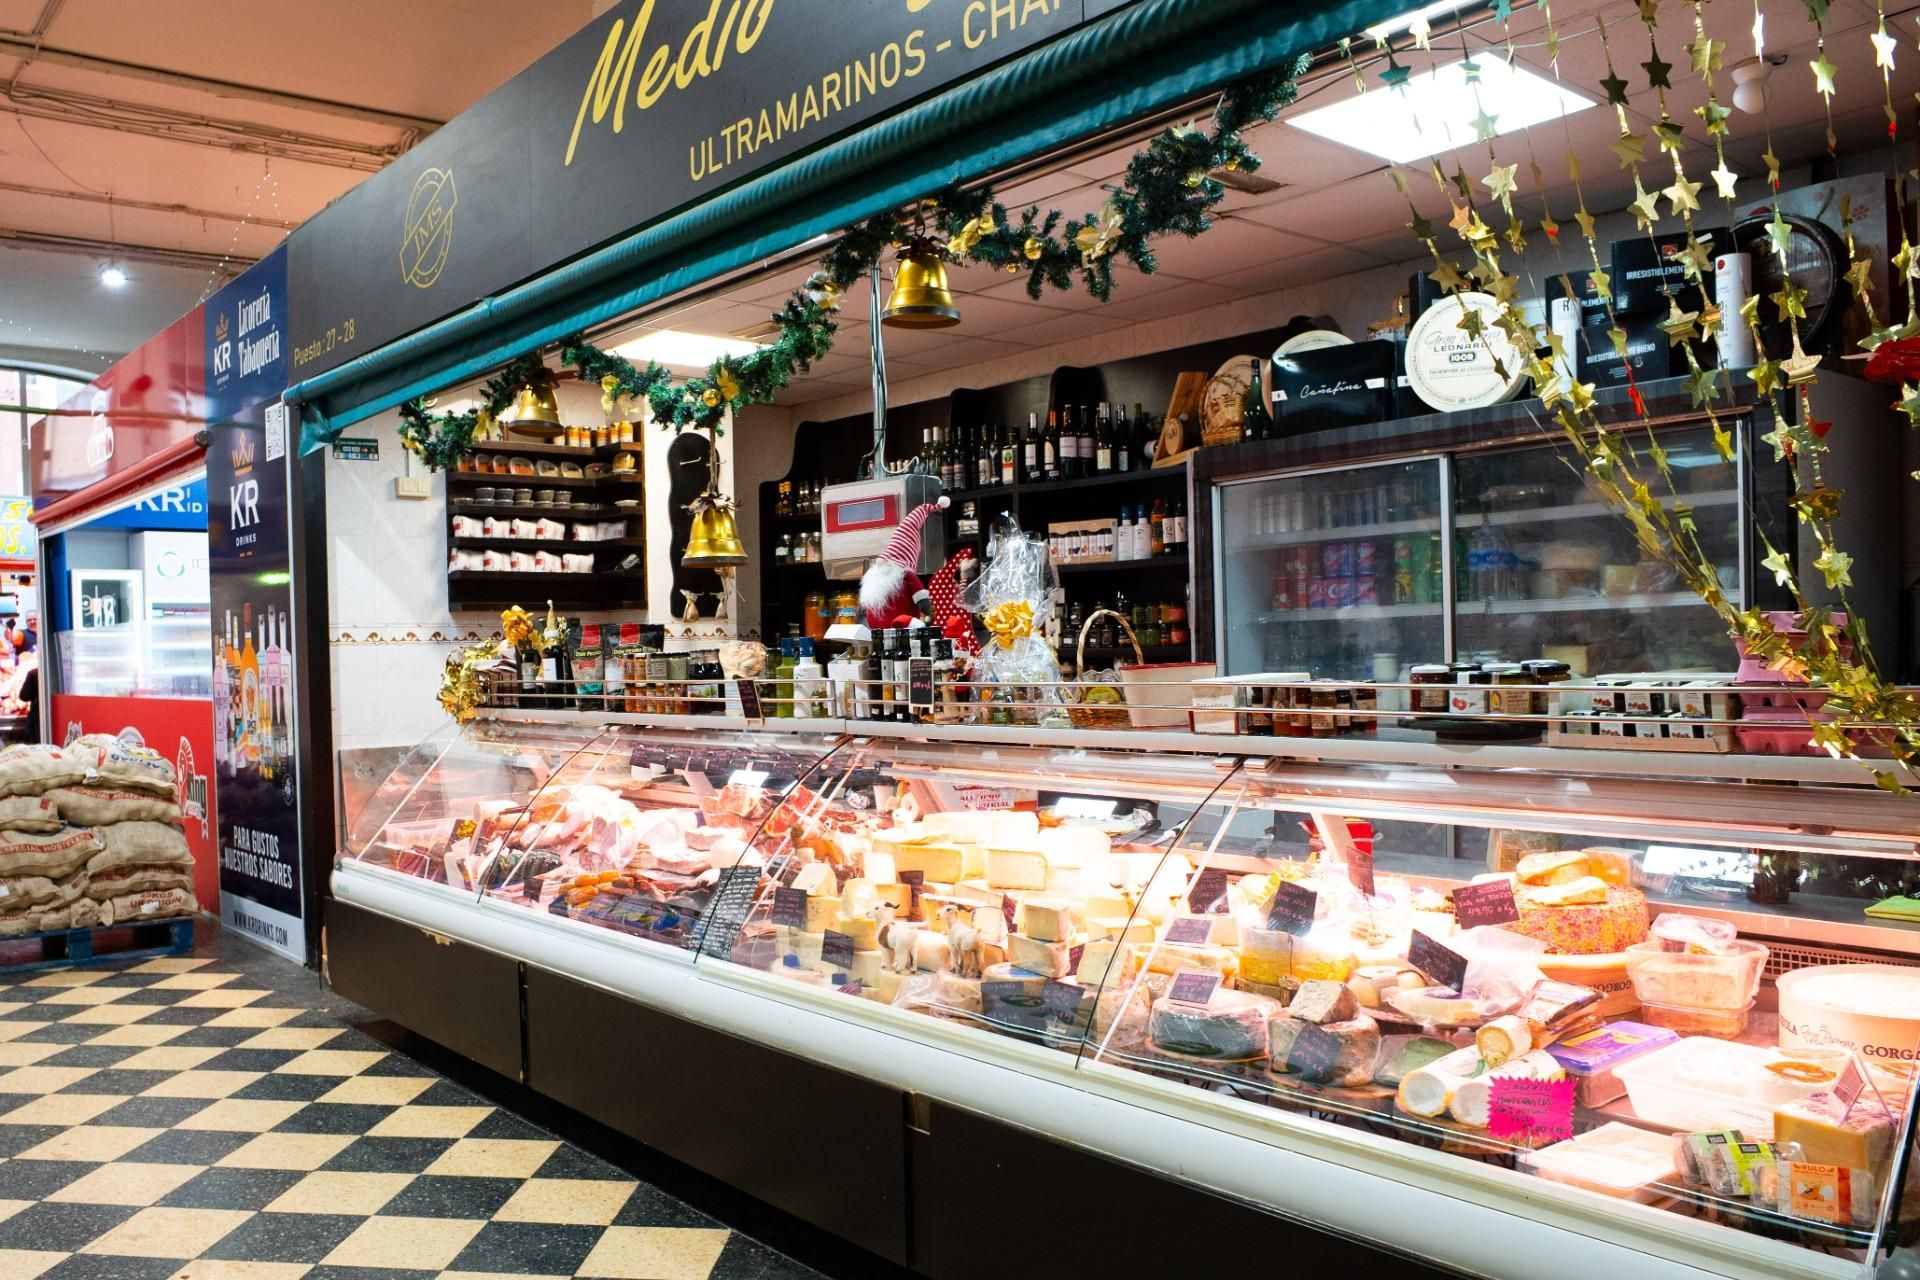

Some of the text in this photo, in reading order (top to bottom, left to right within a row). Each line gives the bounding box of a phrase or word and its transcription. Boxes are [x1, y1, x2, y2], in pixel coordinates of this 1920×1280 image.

[690, 29, 926, 181] ULTRAMARINOS
[326, 327, 337, 352] 27
[343, 318, 356, 344] 28
[214, 341, 232, 376] KR
[230, 479, 262, 531] KR
[236, 535, 258, 548] DRINKS
[234, 825, 279, 860] PARA GUSTOS
[225, 846, 293, 889] NUESTROS SABORES
[1801, 1164, 1826, 1173] RULO
